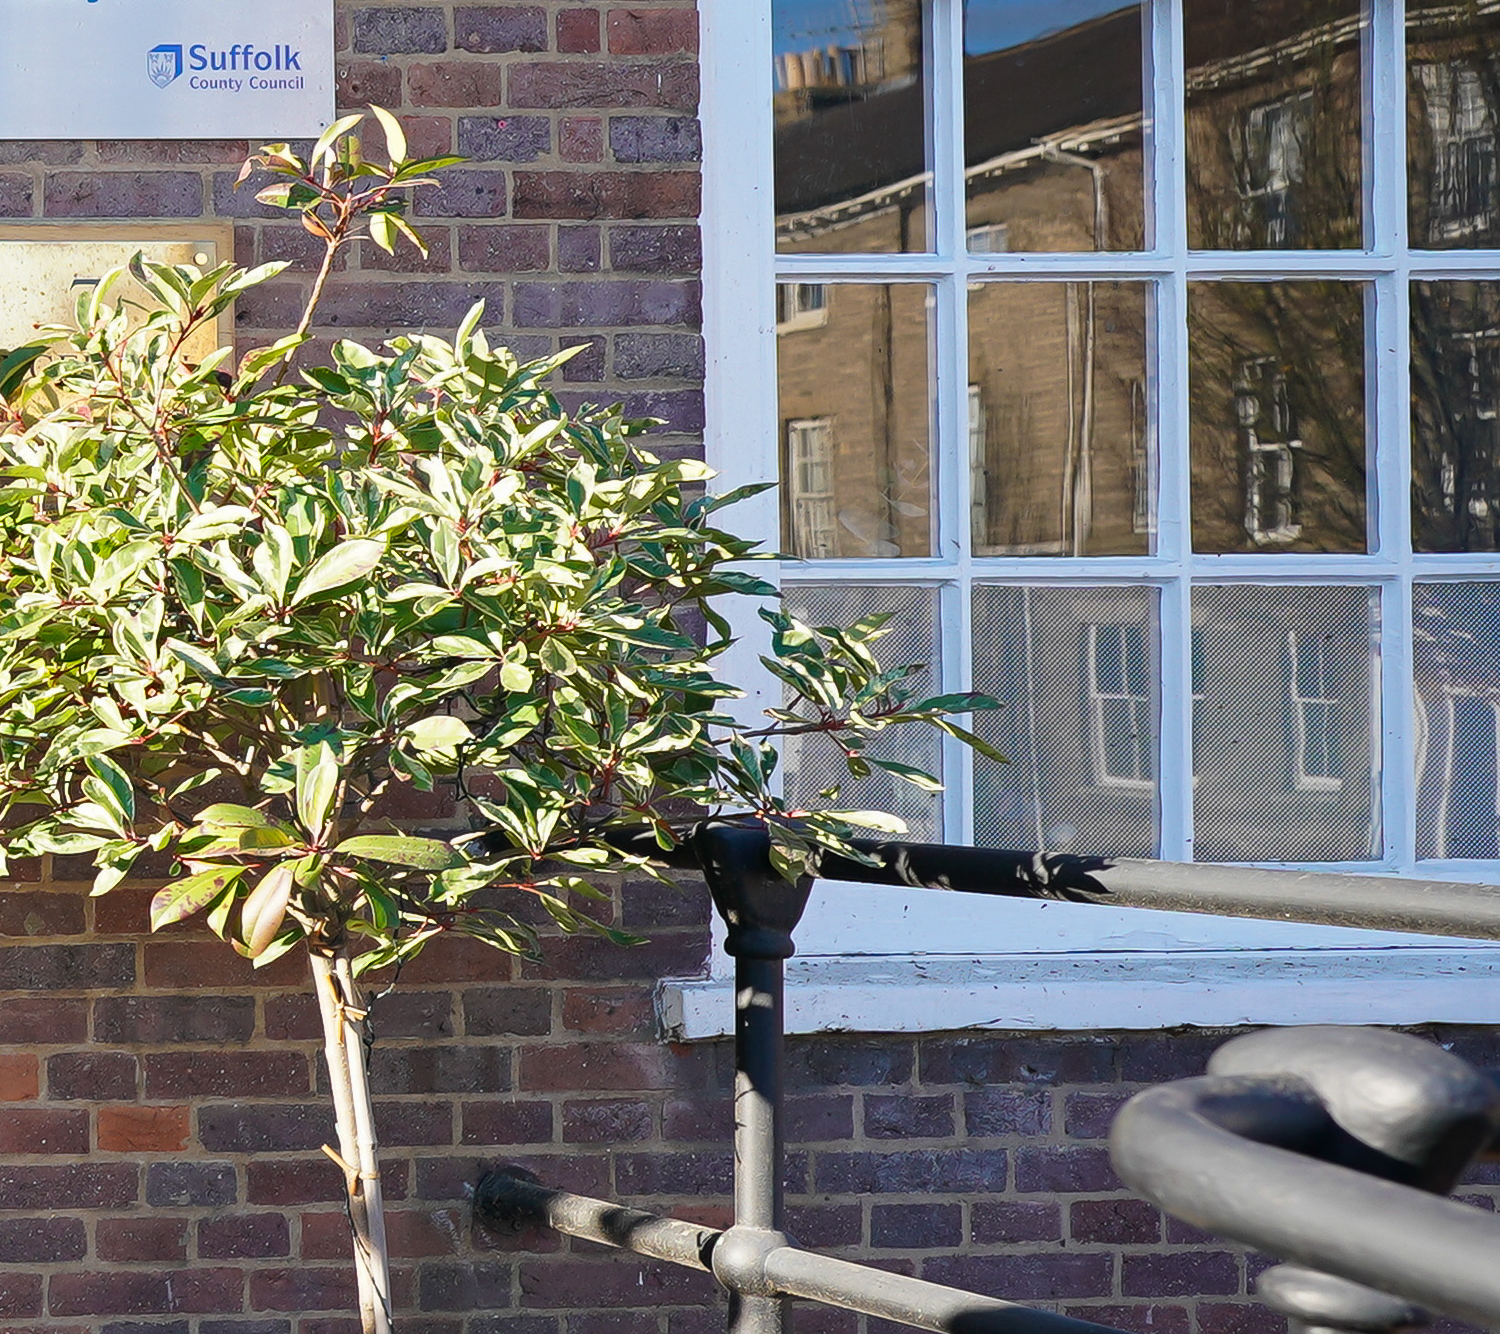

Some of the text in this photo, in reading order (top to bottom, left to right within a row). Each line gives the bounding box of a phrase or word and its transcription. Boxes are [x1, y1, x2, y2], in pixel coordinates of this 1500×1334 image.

[189, 44, 301, 71] Suffolk
[189, 75, 304, 93] County Council
